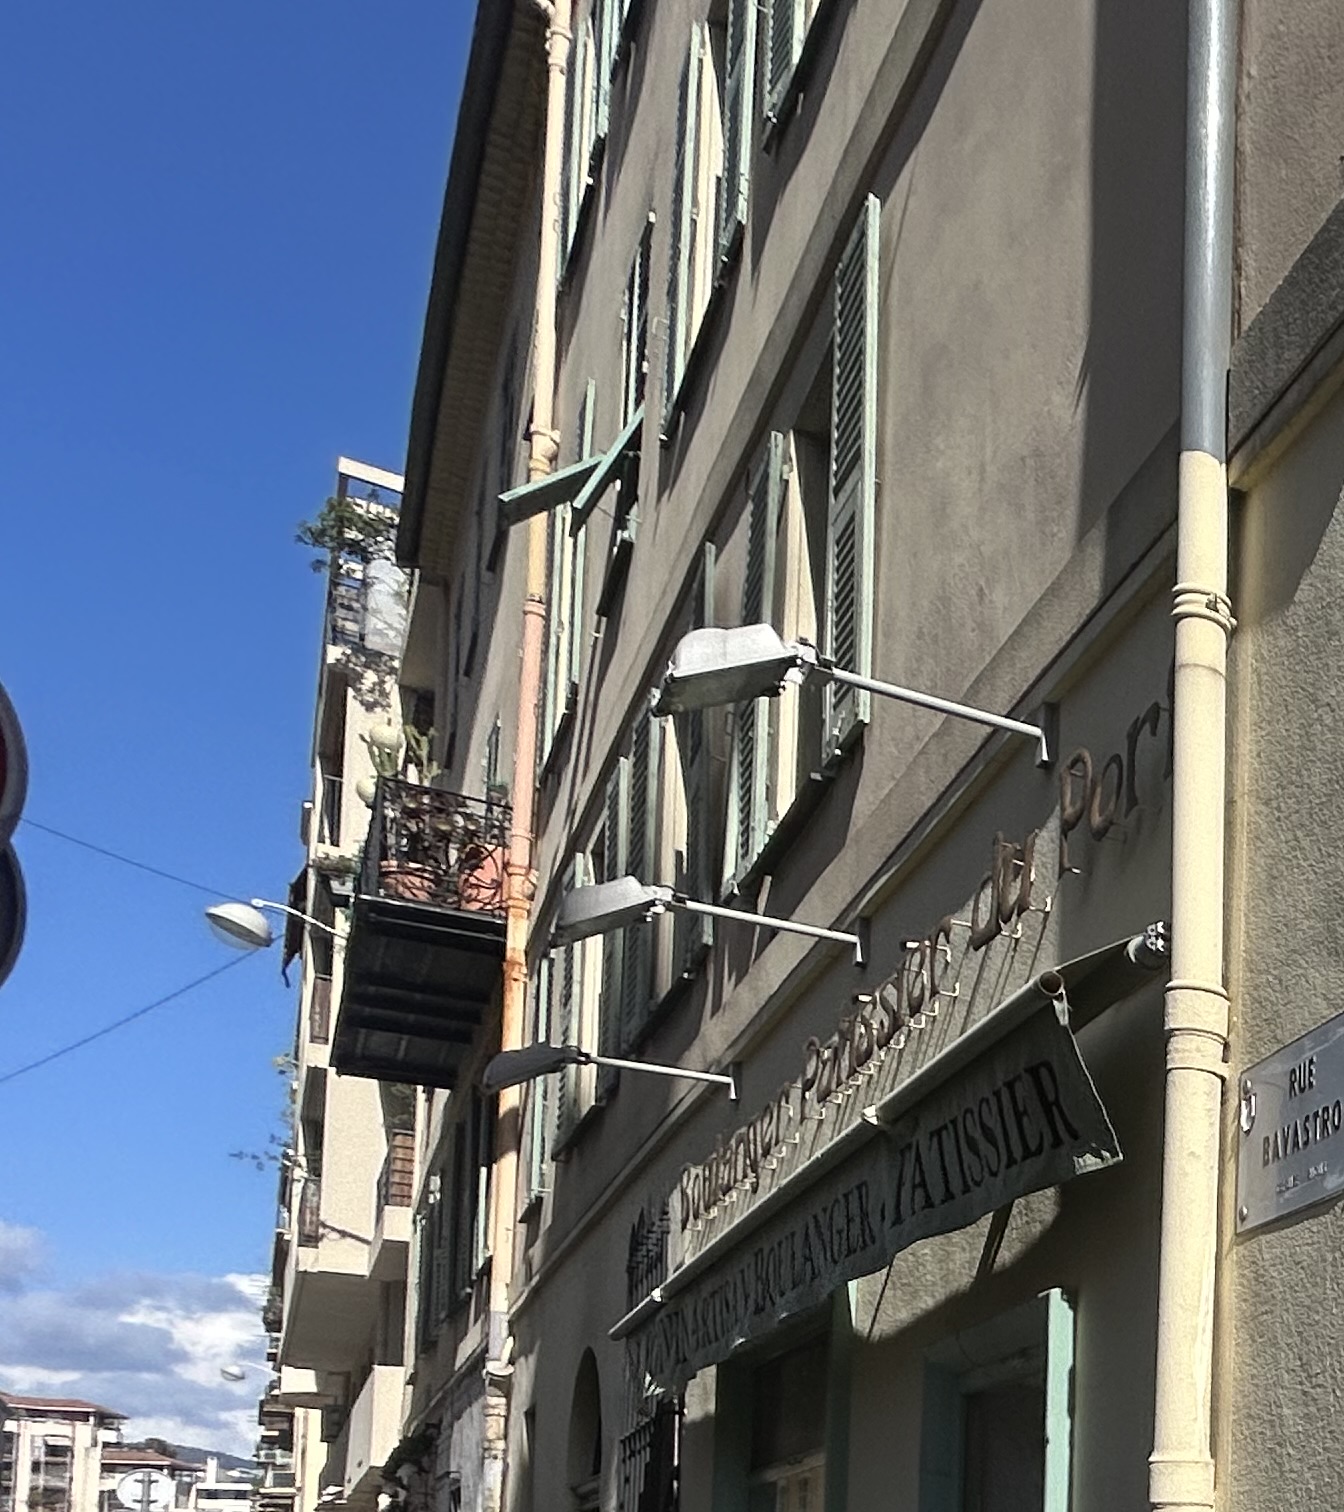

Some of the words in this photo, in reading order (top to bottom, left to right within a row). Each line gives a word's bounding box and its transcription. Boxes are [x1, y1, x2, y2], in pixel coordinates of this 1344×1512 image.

[970, 828, 1038, 951] du
[1060, 695, 1174, 880] Por
[1289, 1055, 1317, 1100] RUE
[1262, 1099, 1342, 1169] BAYASTRO
[754, 1183, 876, 1317] BOULANGER
